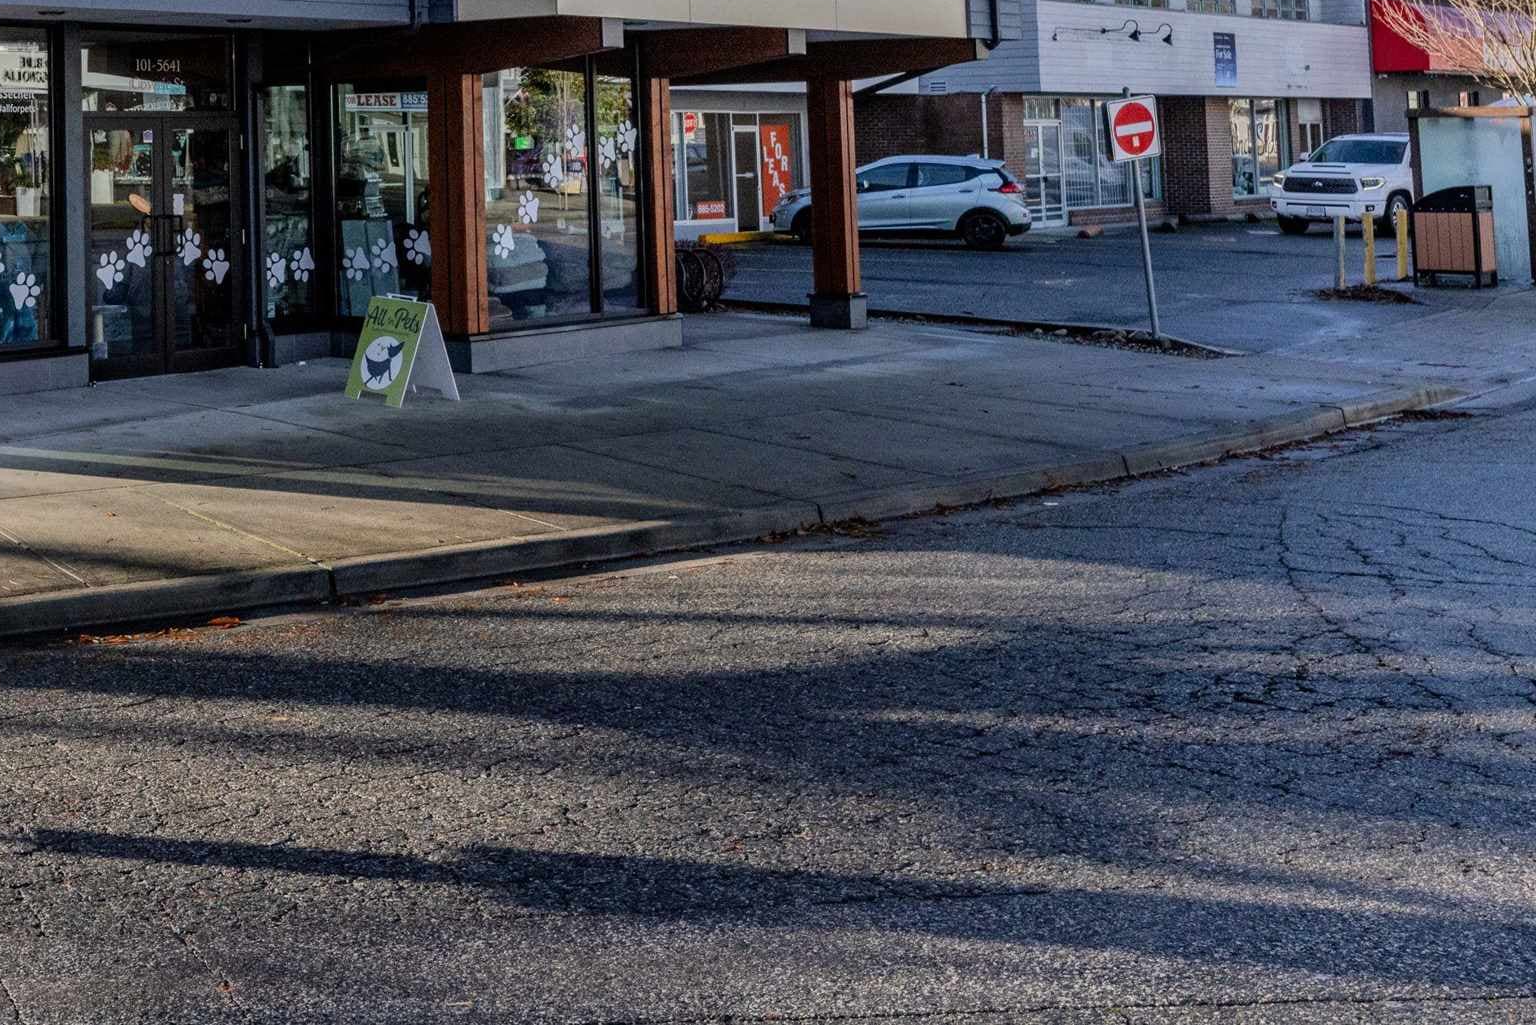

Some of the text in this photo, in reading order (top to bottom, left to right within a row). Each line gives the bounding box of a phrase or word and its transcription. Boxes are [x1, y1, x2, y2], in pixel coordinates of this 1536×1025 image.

[135, 57, 181, 73] 101-5641
[357, 94, 397, 107] LEASE
[770, 131, 788, 171] FOR
[763, 145, 786, 198] LEAS
[366, 305, 387, 328] All
[394, 307, 420, 334] Pets
